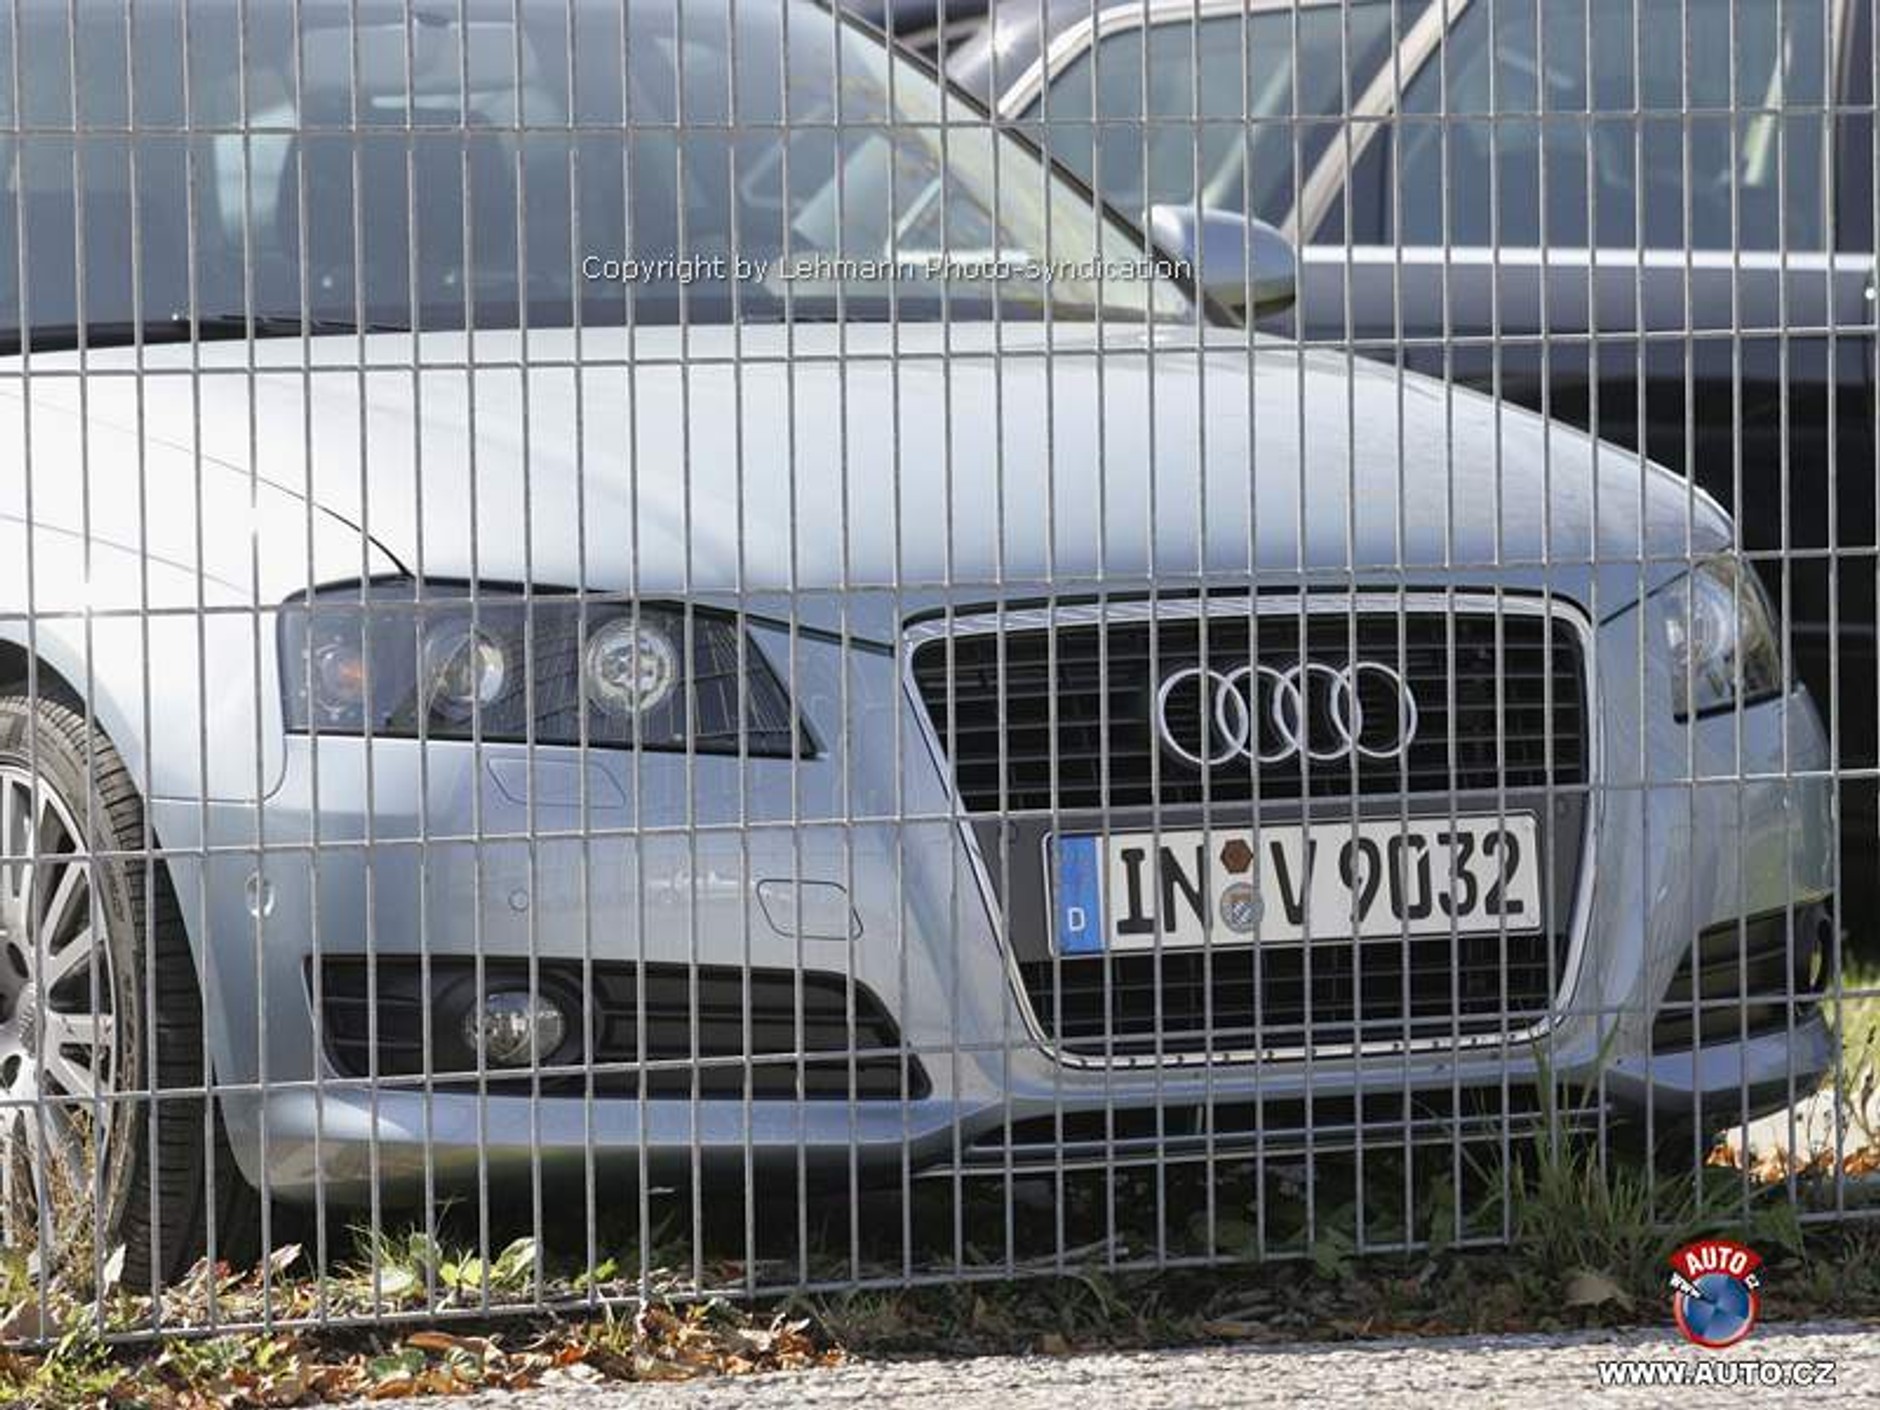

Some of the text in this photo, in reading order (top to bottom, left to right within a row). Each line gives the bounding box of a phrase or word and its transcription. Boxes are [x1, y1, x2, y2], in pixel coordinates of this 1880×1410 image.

[1117, 829, 1524, 934] IN V 9032
[1067, 906, 1086, 933] D
